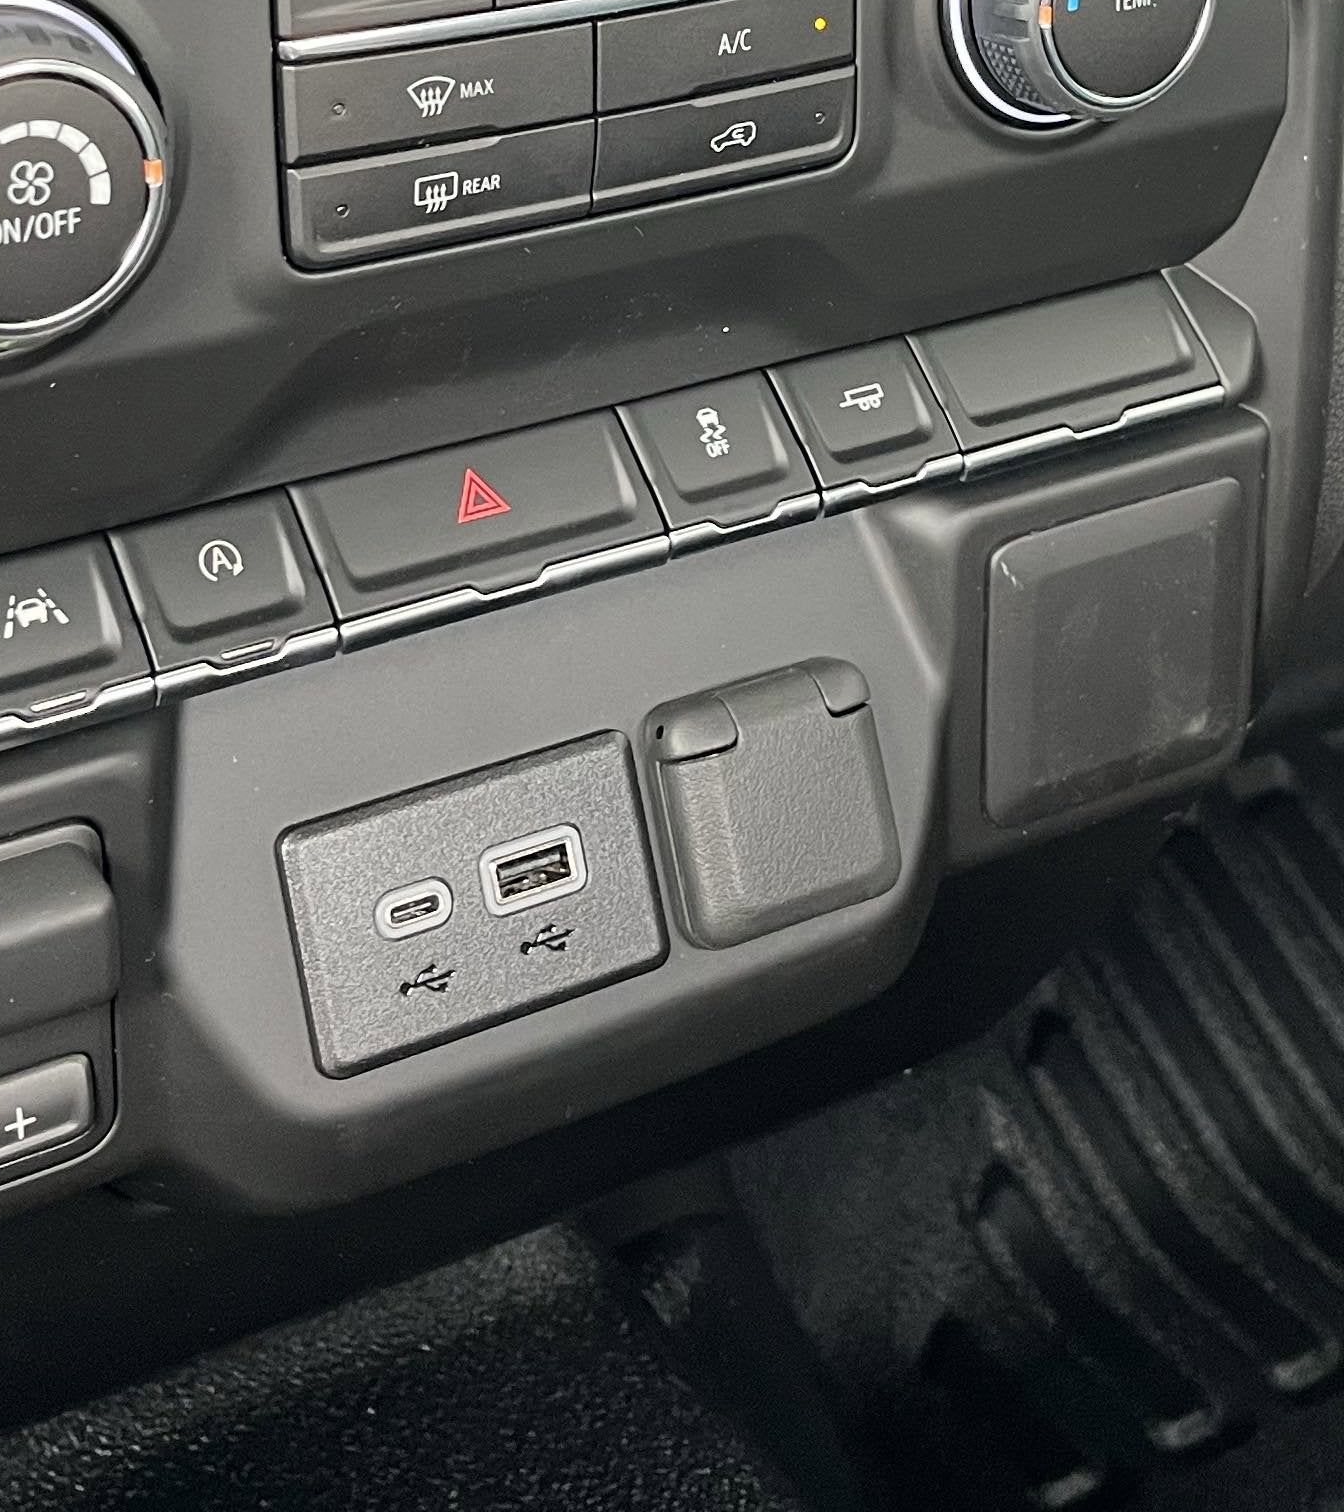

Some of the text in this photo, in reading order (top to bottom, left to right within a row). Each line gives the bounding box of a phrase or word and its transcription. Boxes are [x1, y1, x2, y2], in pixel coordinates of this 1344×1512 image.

[717, 28, 752, 57] A/C
[459, 78, 495, 100] MAX
[462, 174, 501, 196] REAR
[705, 439, 730, 458] OFF
